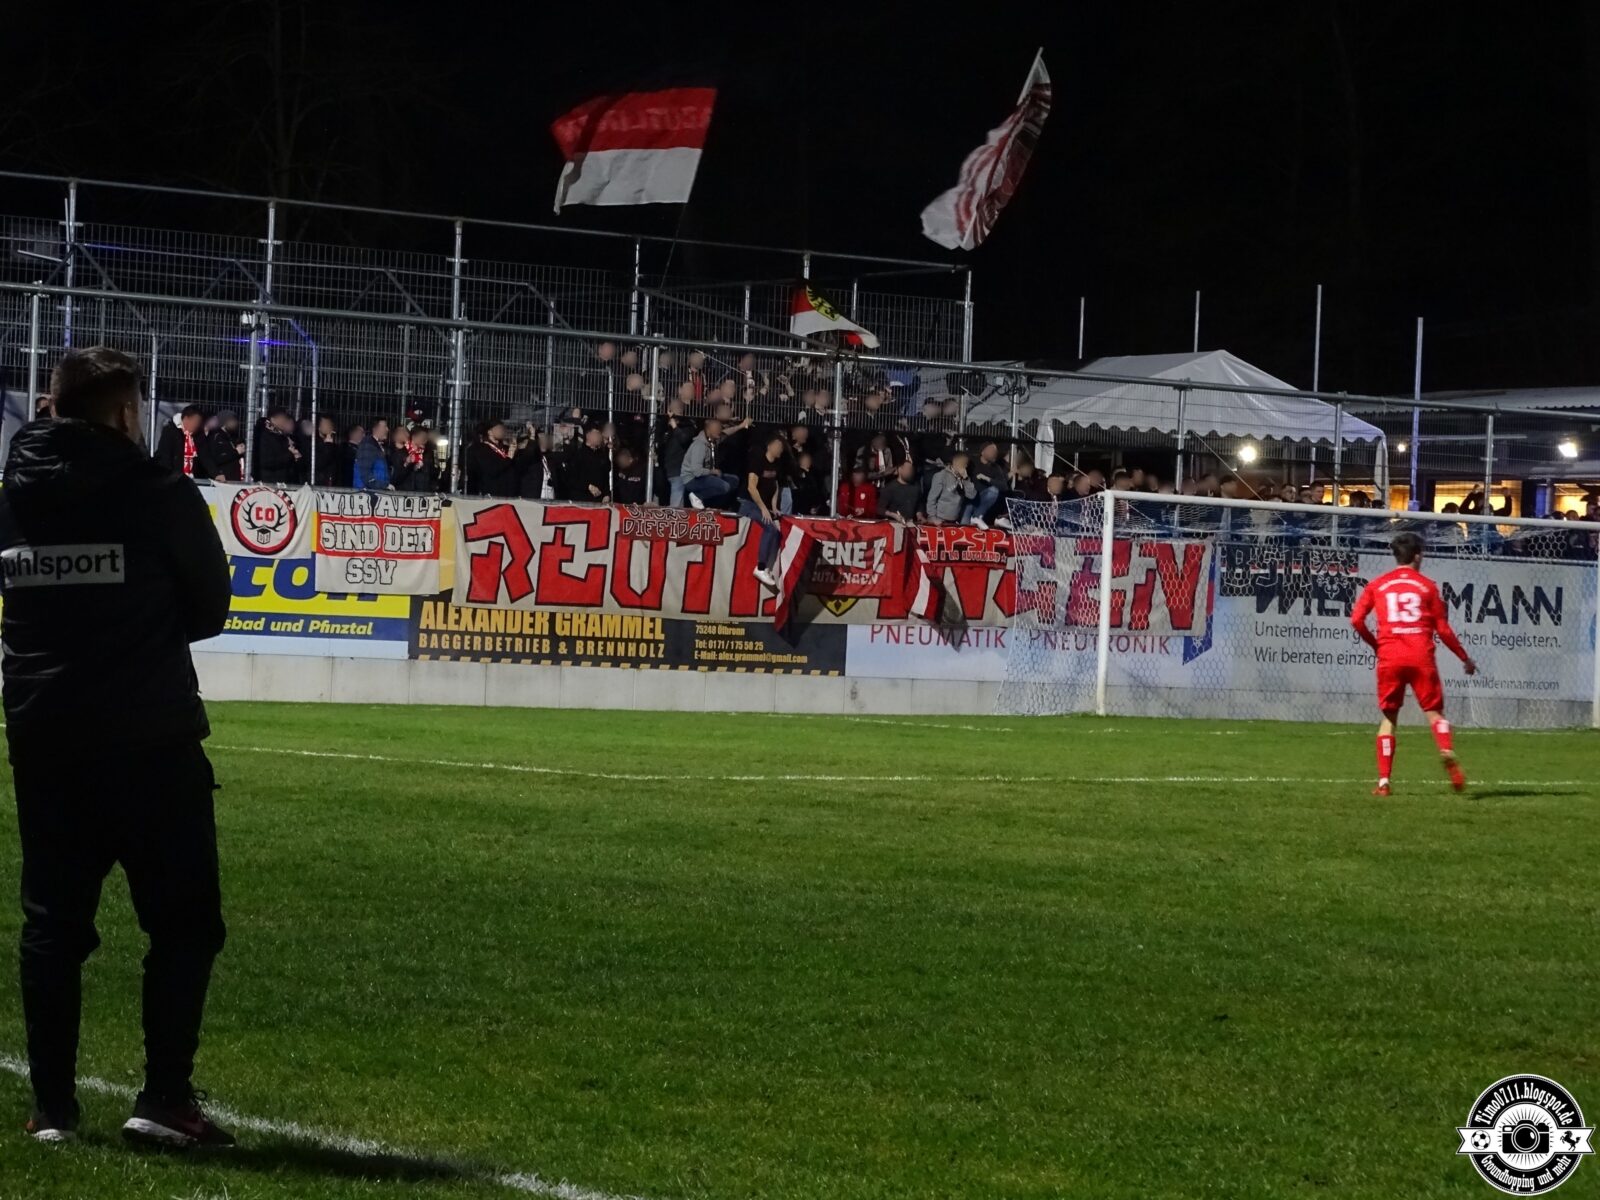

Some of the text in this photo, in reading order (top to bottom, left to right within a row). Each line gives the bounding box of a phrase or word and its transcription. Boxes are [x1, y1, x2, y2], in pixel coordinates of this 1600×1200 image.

[319, 494, 372, 517] WIR
[375, 493, 442, 519] ALLE
[320, 521, 434, 554] SIND DER
[918, 526, 1006, 552] TPSP
[0, 549, 120, 580] uhlsport
[345, 558, 398, 586] SSV
[1385, 591, 1423, 623] 13
[270, 620, 304, 633] und
[308, 620, 373, 636] Pfinztal
[419, 601, 665, 640] ALEXANDER GRAMMEL
[419, 633, 665, 659] BAGGERBETRIEB & BRENNHOLZ
[695, 639, 707, 649] Tel:
[870, 623, 1007, 649] PNEUMATIK
[1254, 621, 1349, 640] Unternehmen
[1491, 630, 1561, 650] begeistern.
[1254, 646, 1278, 663] Wir
[1281, 648, 1333, 665] beraten
